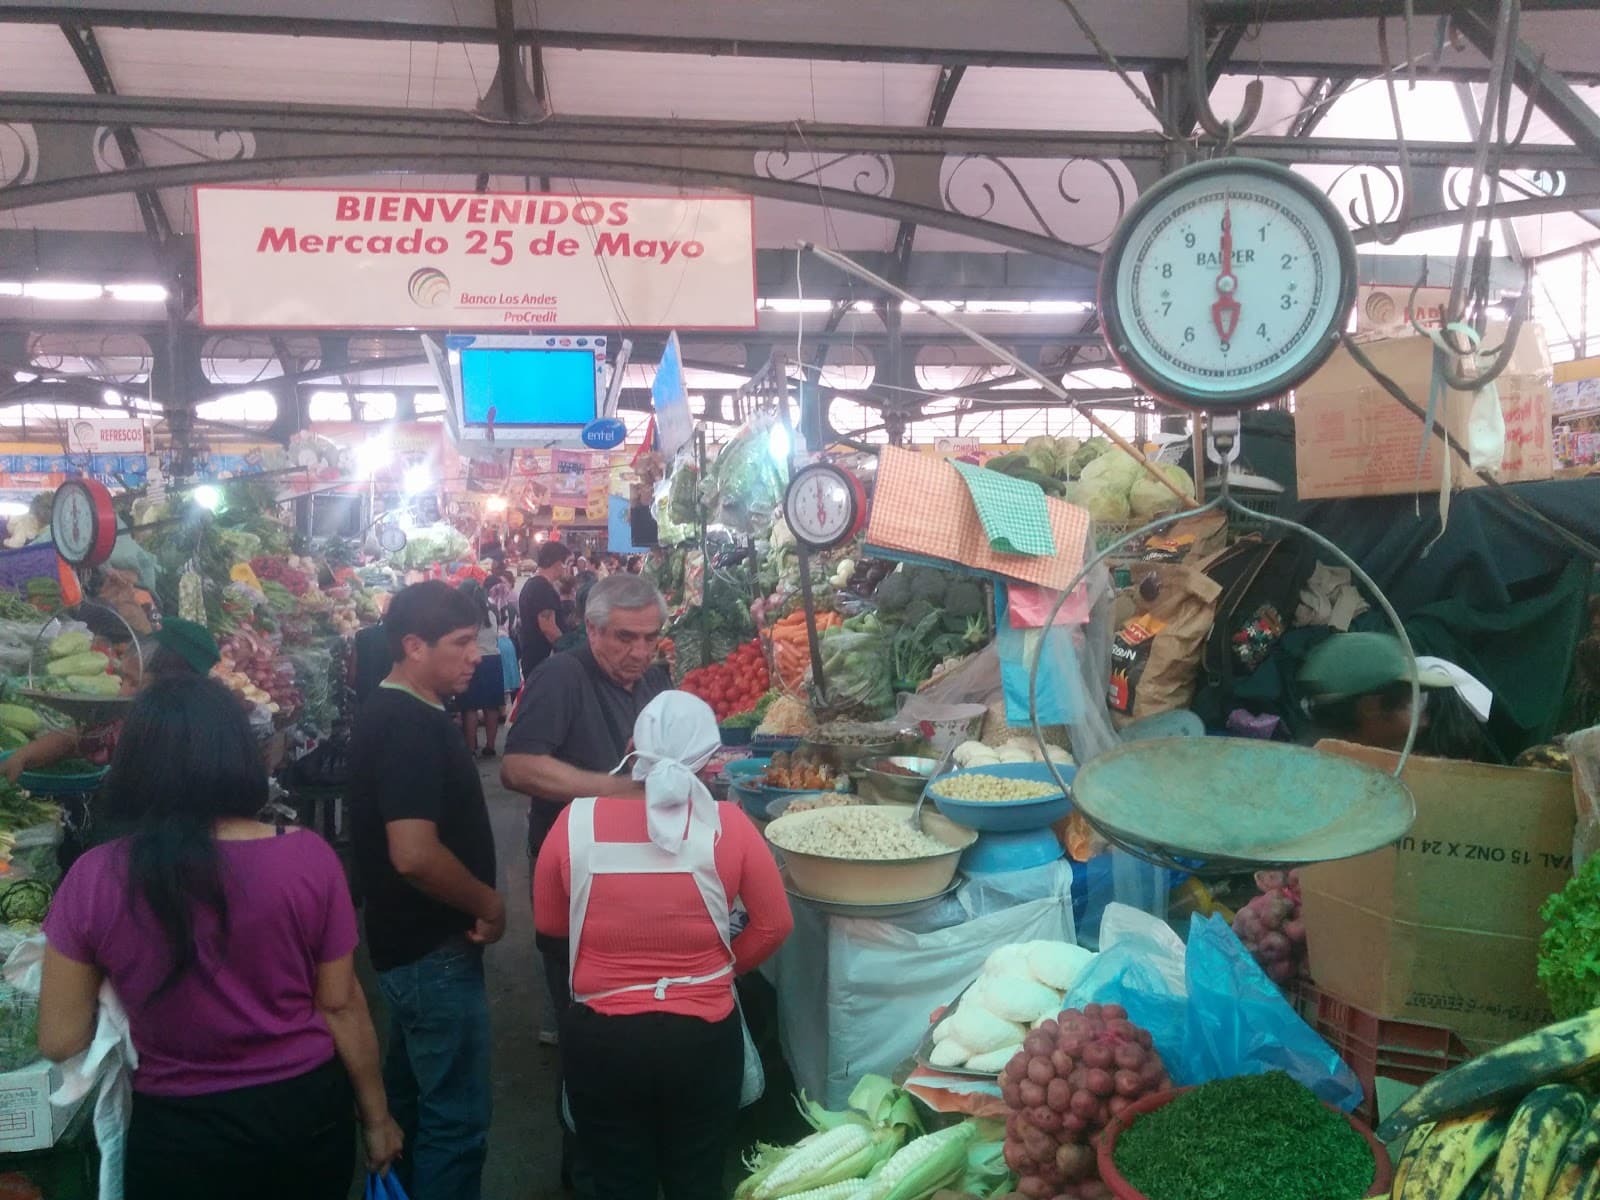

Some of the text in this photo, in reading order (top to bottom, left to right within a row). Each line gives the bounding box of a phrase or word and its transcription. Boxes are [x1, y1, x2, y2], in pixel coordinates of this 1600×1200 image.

[335, 196, 629, 226] BIENVENIDOS
[1184, 232, 1196, 248] 9
[1258, 226, 1266, 242] 1
[256, 227, 705, 266] Mercado 25 de Mayo
[1280, 254, 1292, 270] 2
[1161, 263, 1173, 279] 8
[460, 293, 558, 305] Banco Los Andes
[1280, 294, 1291, 310] 3
[504, 311, 557, 323] ProCredit
[1161, 301, 1172, 317] 7
[1184, 326, 1195, 342] 6
[1256, 322, 1267, 338] 4
[100, 428, 143, 441] REFRESCOS
[587, 429, 615, 441] entel
[1421, 839, 1442, 855] 24
[1447, 842, 1460, 857] X
[1465, 844, 1505, 862] ONZ
[1511, 850, 1531, 865] 15
